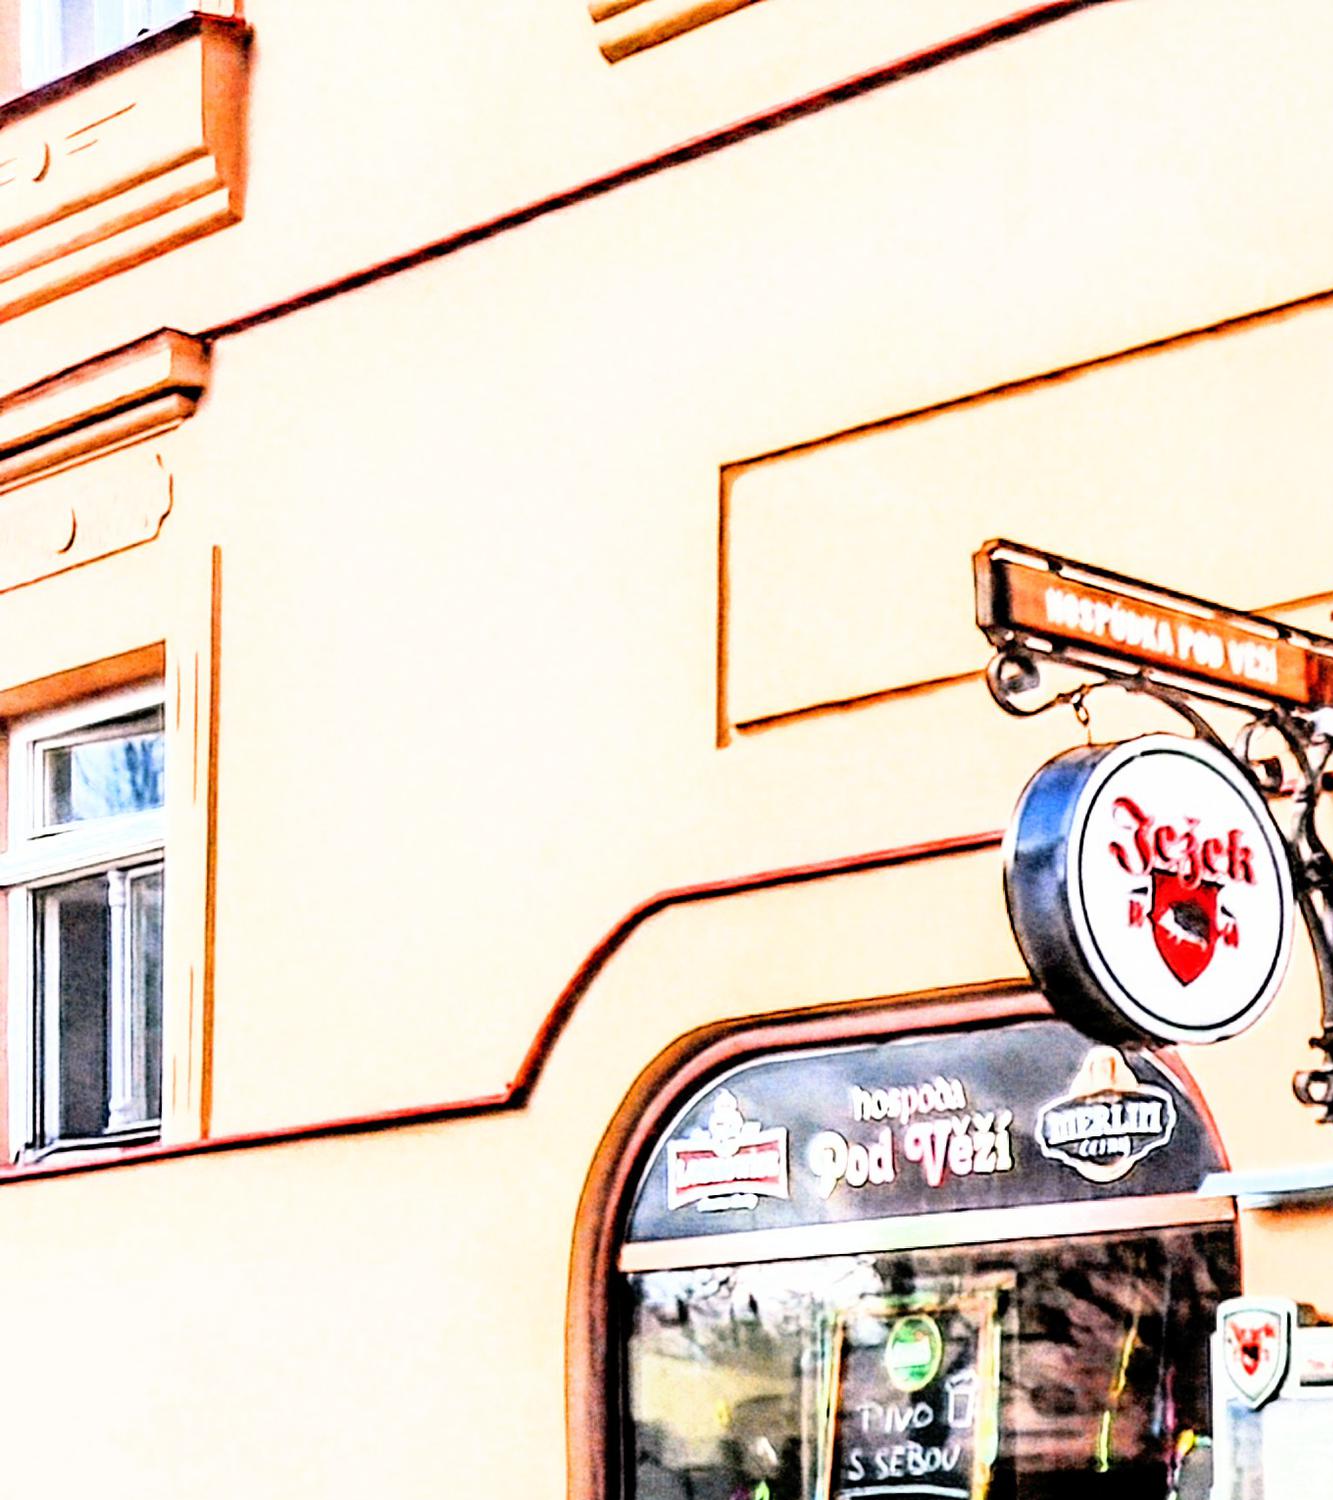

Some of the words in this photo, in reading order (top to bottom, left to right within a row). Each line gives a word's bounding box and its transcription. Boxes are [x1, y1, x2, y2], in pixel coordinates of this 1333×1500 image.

[851, 1074, 968, 1125] hospoda
[808, 1124, 897, 1200] Pod
[903, 1108, 1015, 1187] Věží
[856, 1400, 934, 1435] PIVO
[874, 1440, 961, 1480] SEBOU
